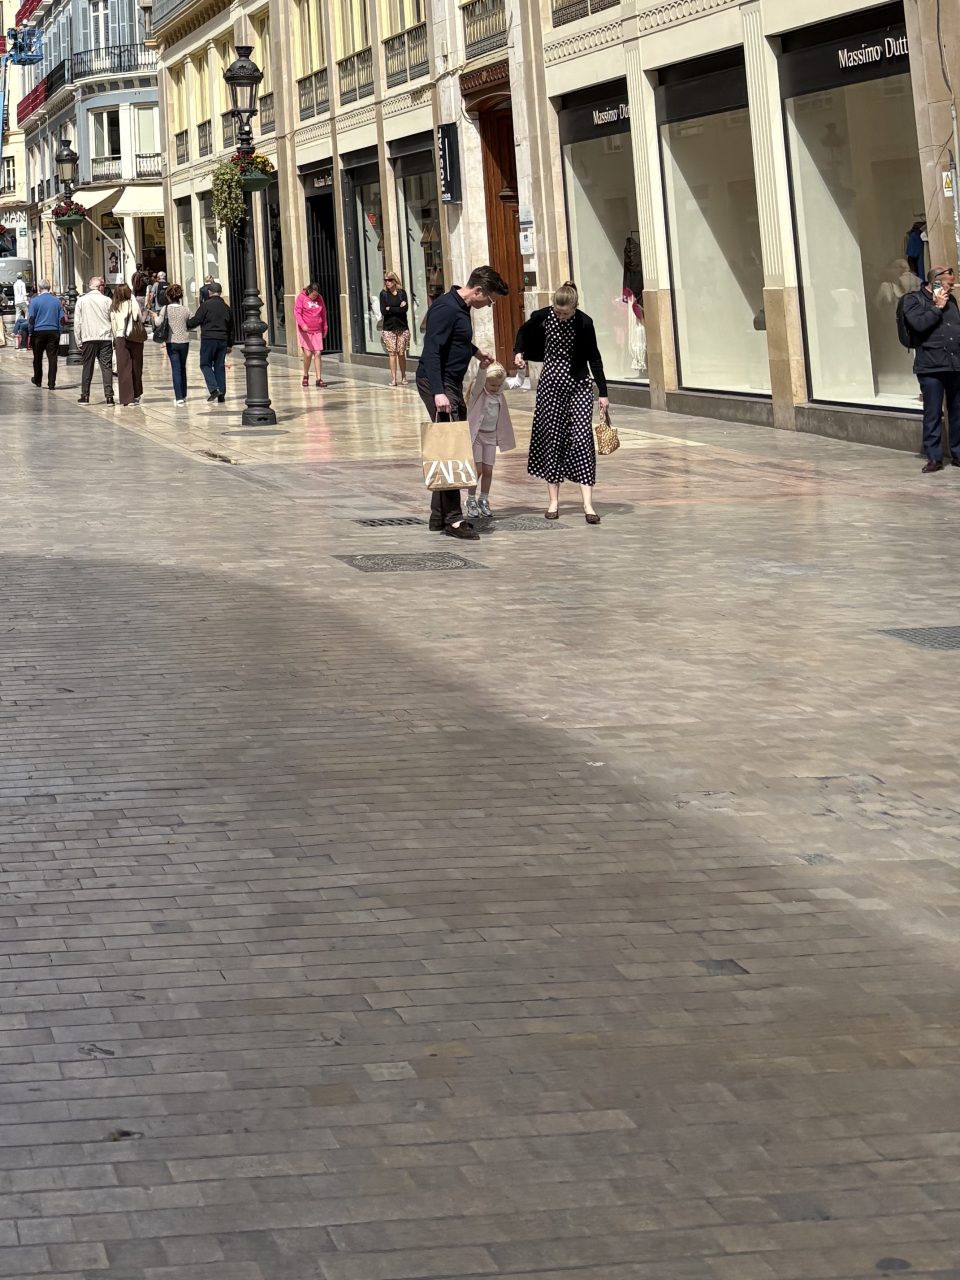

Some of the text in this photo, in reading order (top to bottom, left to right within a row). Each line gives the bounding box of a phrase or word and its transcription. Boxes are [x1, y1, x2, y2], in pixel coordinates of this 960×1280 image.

[838, 43, 882, 69] Massimo
[592, 107, 618, 126] Massimo
[422, 459, 478, 486] ZARA
